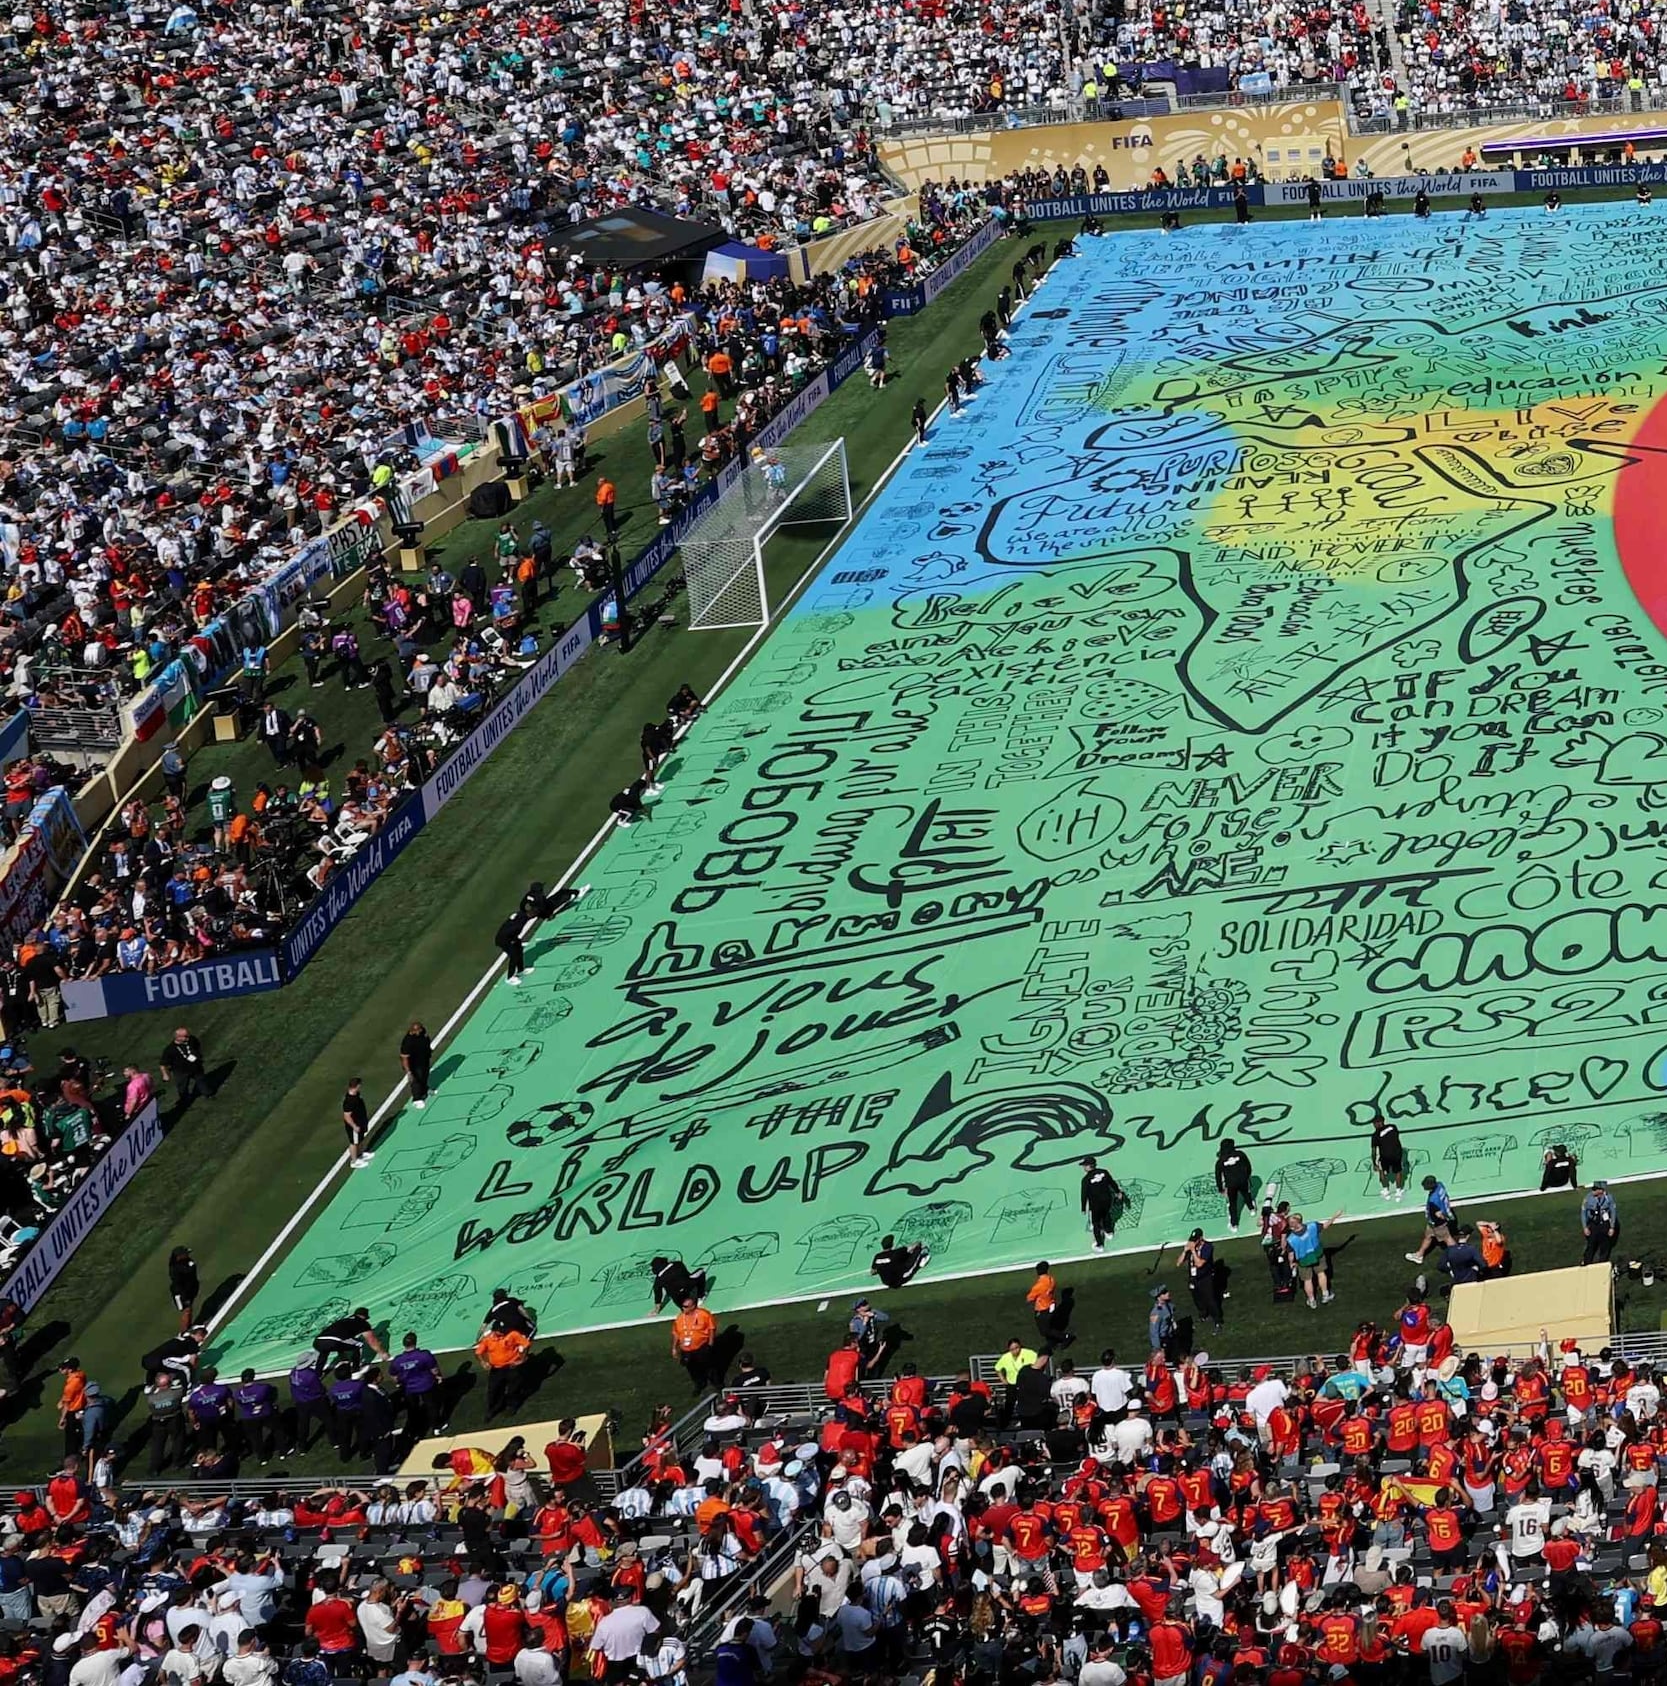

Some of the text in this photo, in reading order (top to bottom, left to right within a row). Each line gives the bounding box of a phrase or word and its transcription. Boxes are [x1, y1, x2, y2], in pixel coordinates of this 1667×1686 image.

[1112, 134, 1154, 150] FIFA
[1531, 170, 1590, 187] FOOTBALL
[1594, 168, 1637, 186] UNITES
[1639, 165, 1664, 183] the
[1090, 187, 1209, 214] UNITES the World
[806, 379, 822, 406] FIFA
[1447, 371, 1641, 400] educación
[1018, 489, 1220, 530] Future
[632, 544, 661, 587] UNITES
[1215, 533, 1462, 566] END POVERTY
[1272, 557, 1367, 576] NOW
[436, 634, 583, 802] FOOTBALL UNITES the World FIFA
[1141, 761, 1345, 814] NEVER
[290, 816, 413, 967] UNITES the World FIFA
[1219, 910, 1444, 959] SOLIDARIDAD
[52, 1156, 128, 1259] UNITES the
[453, 1162, 723, 1260] WORLD
